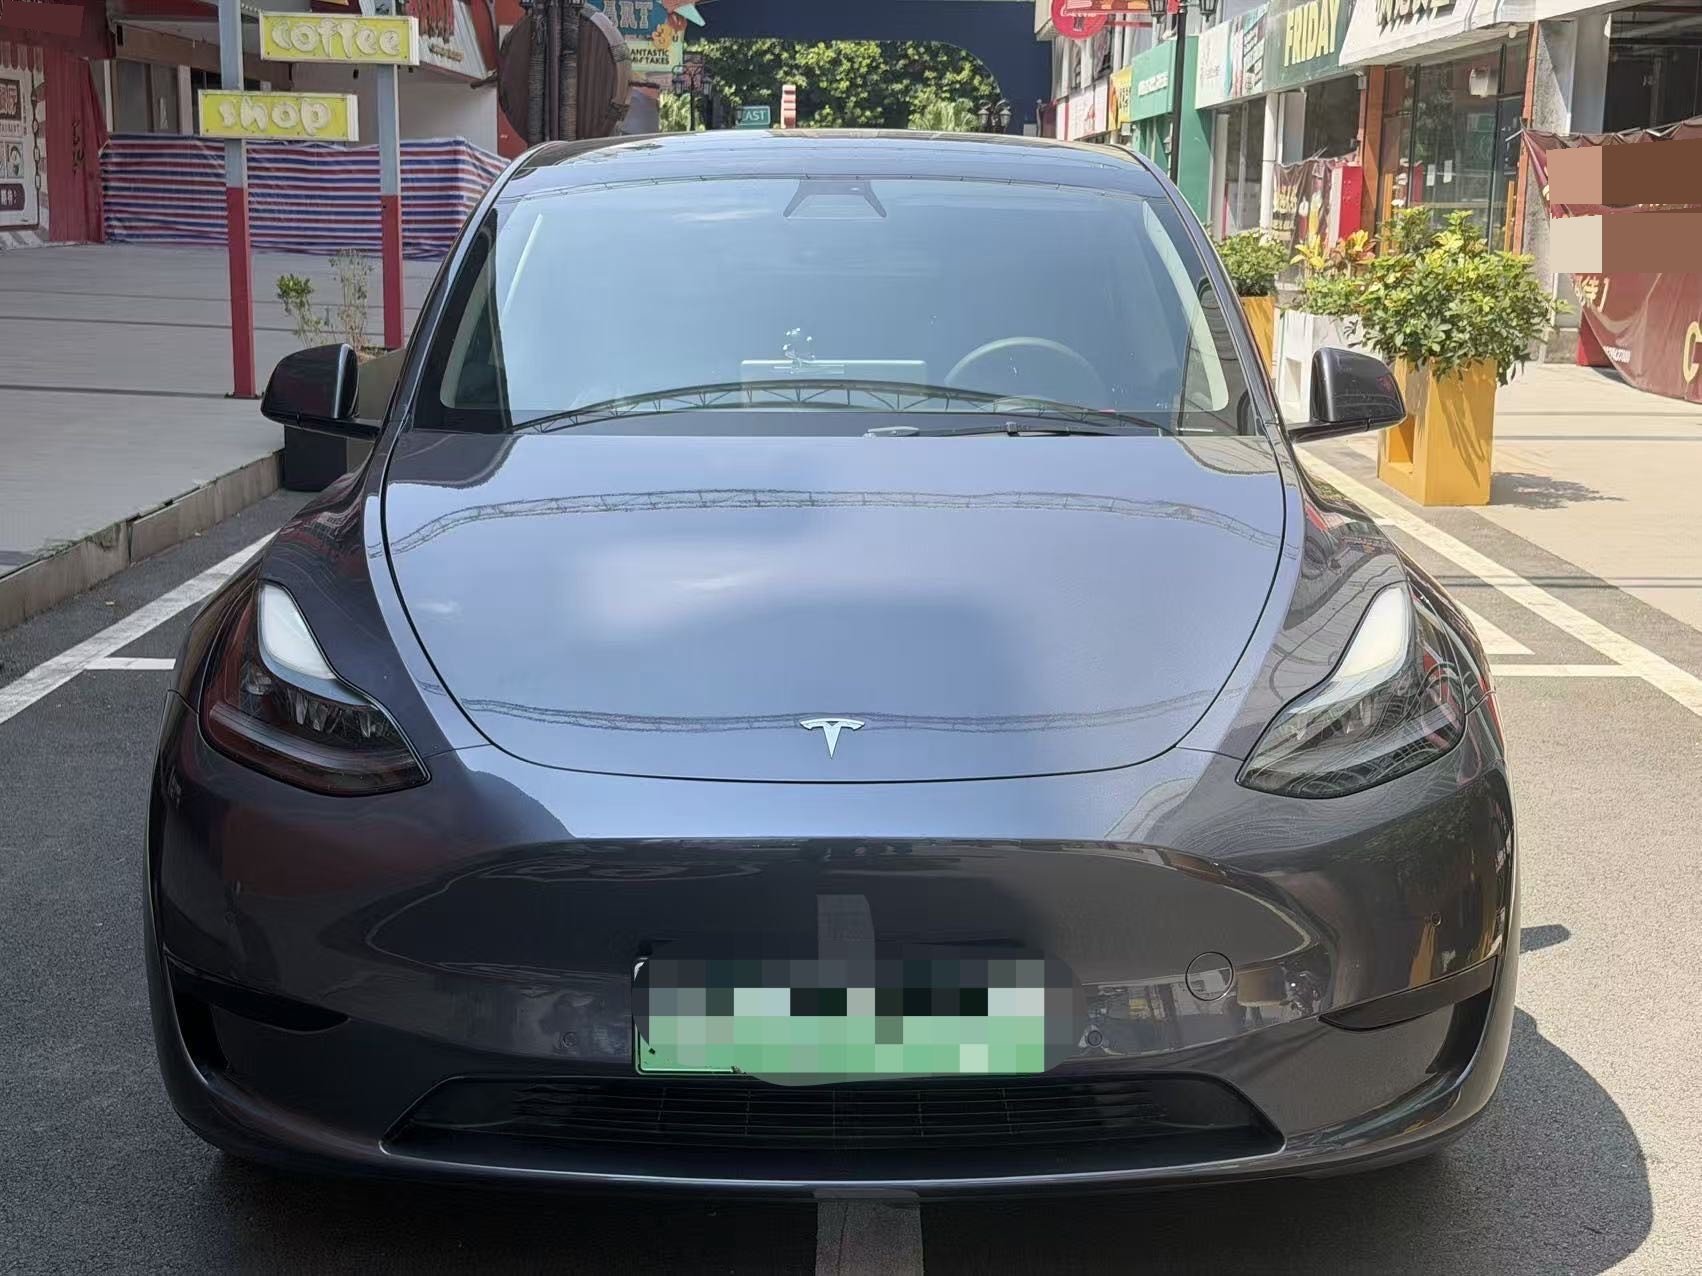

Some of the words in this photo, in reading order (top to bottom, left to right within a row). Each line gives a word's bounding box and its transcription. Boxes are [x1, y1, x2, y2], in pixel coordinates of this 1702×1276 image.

[272, 16, 401, 58] coffee
[630, 48, 669, 57] ANTASTIC
[1284, 0, 1340, 67] FRIDAY
[218, 95, 332, 136] shop
